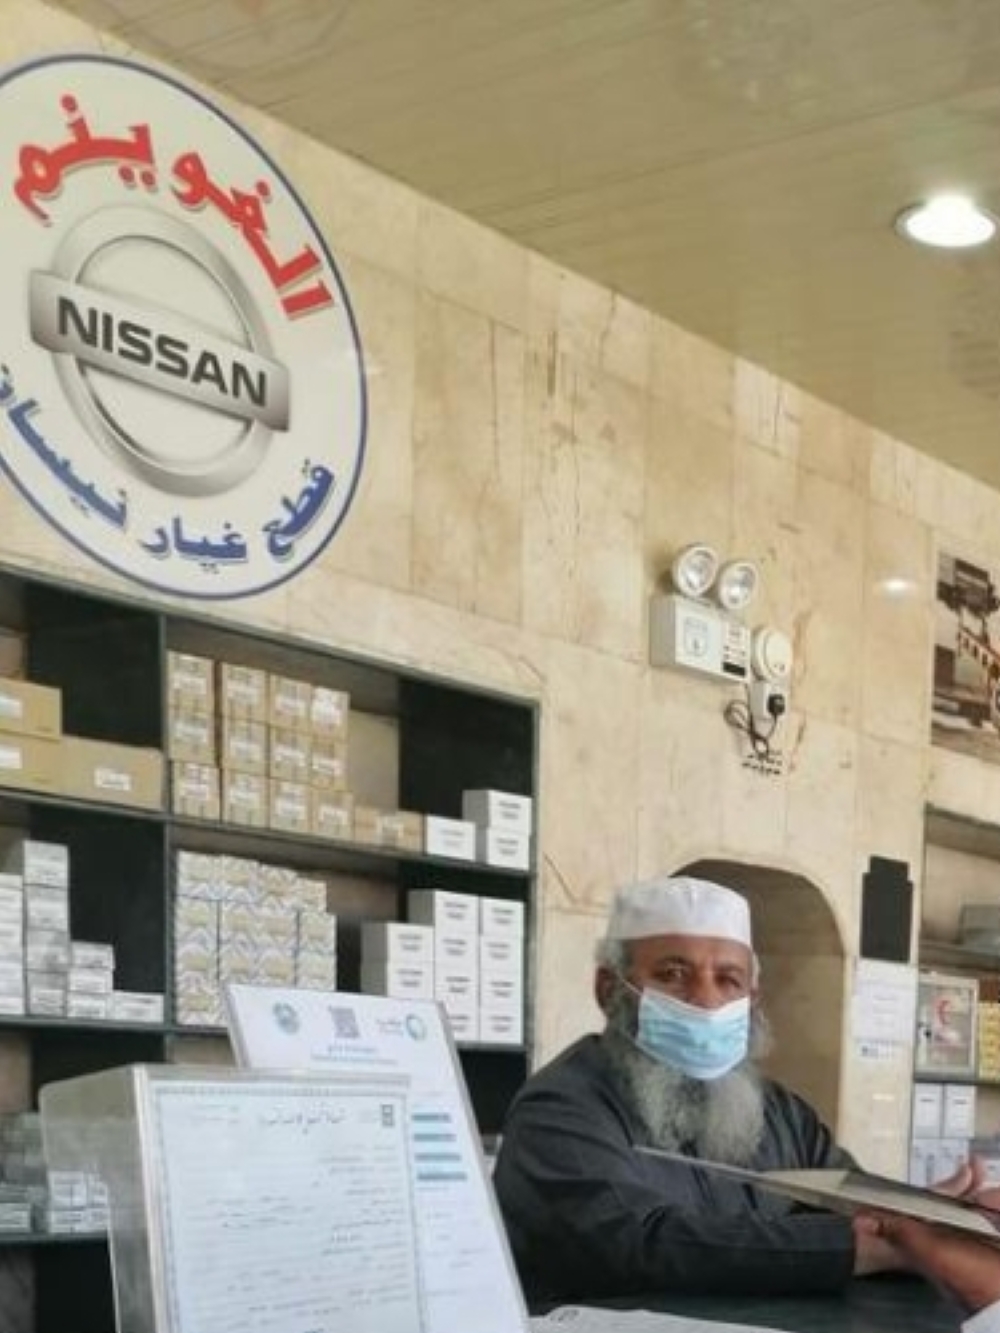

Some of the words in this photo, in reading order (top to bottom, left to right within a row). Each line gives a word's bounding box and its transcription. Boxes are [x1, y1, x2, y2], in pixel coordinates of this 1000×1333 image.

[57, 295, 267, 408] NISSAN
[137, 515, 248, 574] غيار
[262, 459, 335, 557] قطع
